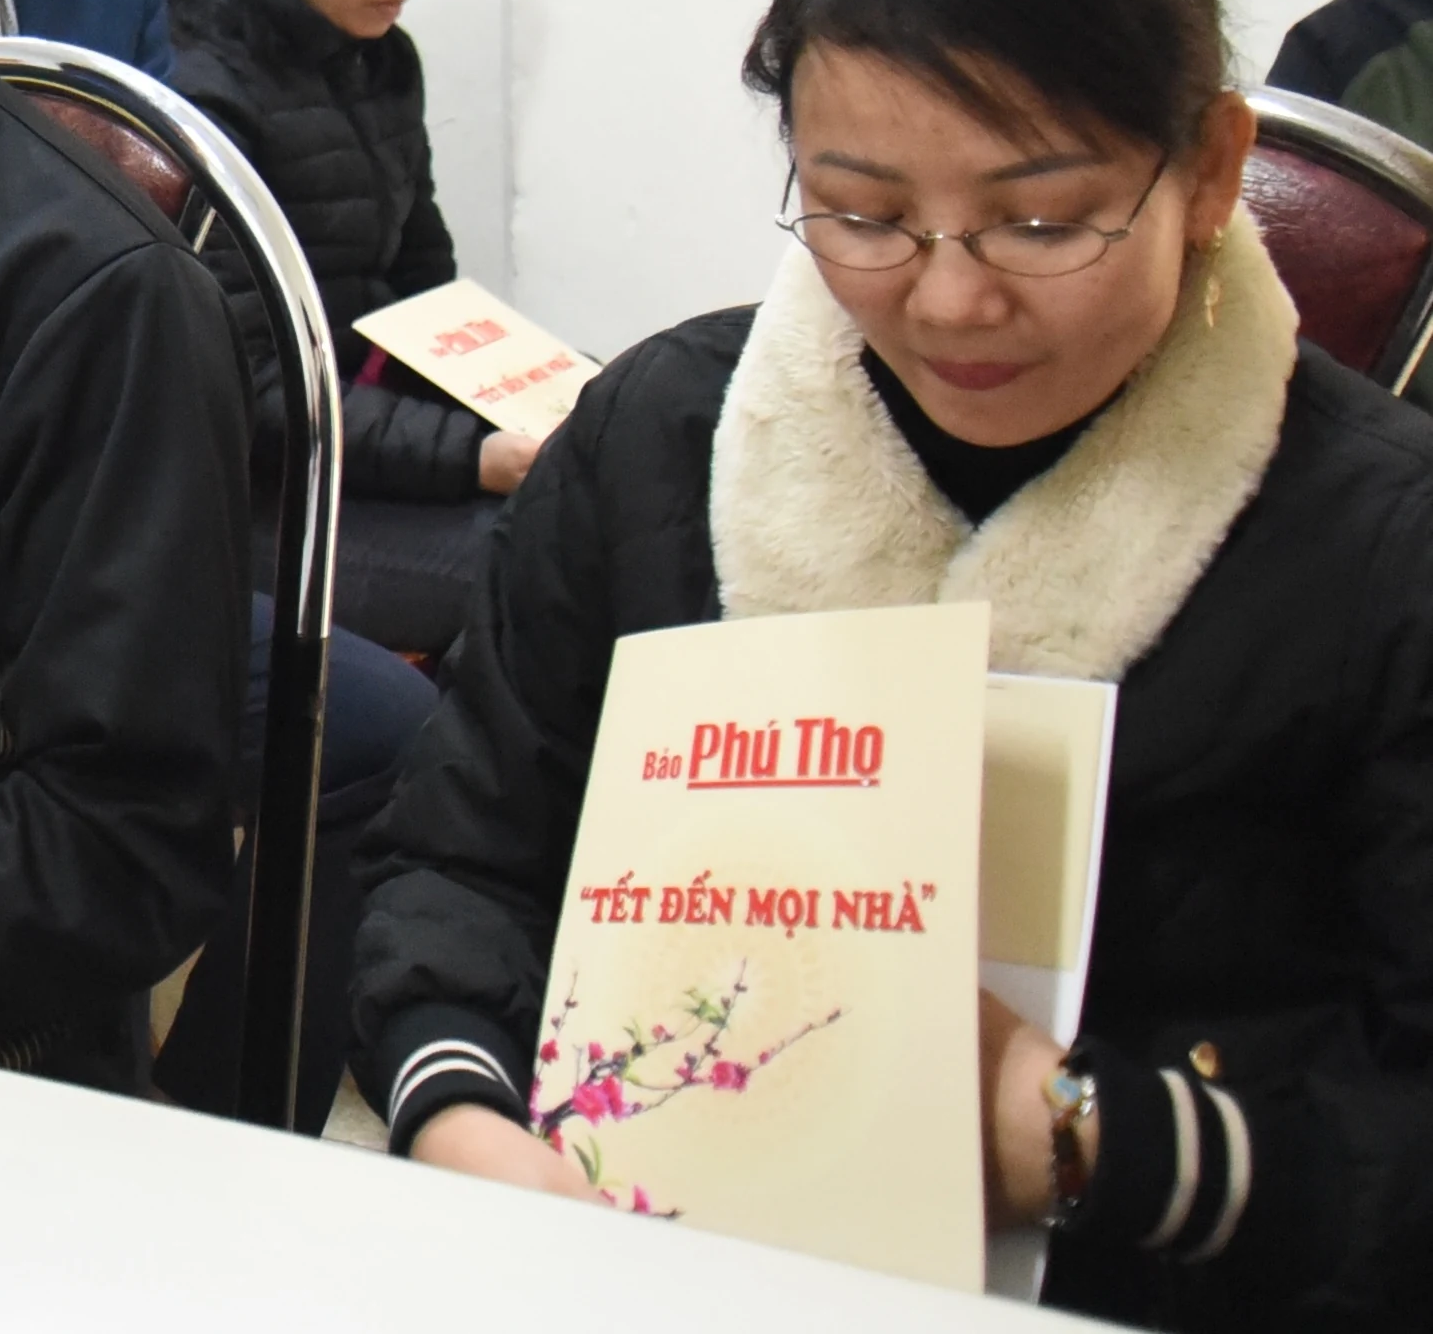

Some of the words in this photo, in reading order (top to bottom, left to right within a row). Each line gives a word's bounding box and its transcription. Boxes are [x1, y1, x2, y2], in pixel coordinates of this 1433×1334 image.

[641, 747, 683, 782] Báo
[687, 719, 782, 781] Phú
[794, 717, 885, 787] Thọ
[657, 869, 737, 926] ĐẾN
[744, 886, 821, 940] MỌI
